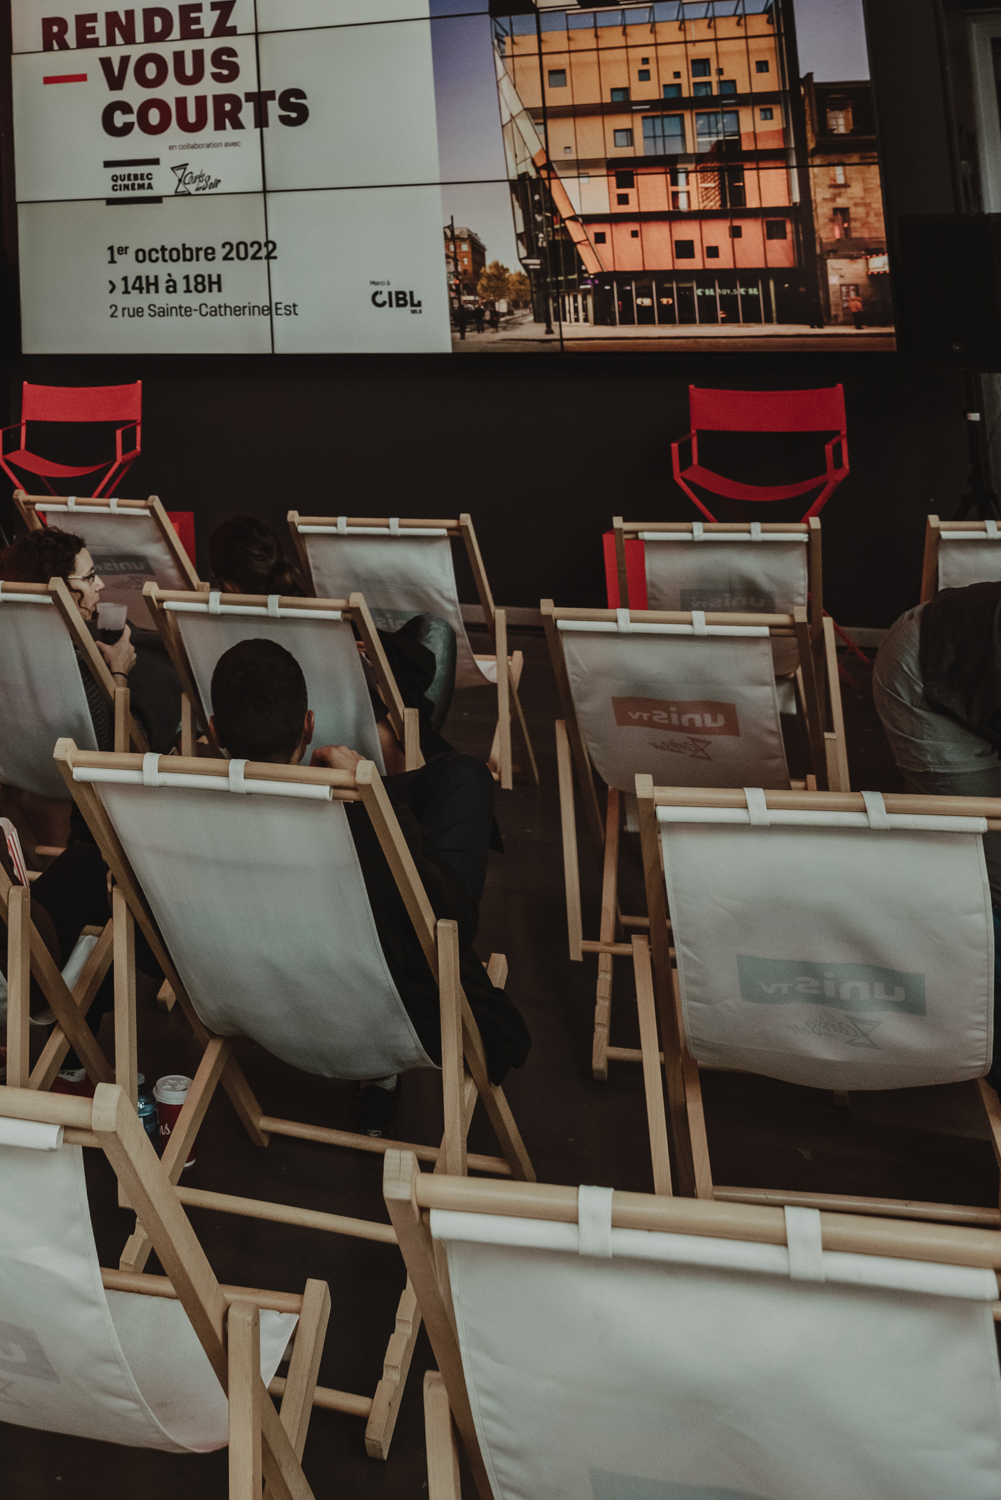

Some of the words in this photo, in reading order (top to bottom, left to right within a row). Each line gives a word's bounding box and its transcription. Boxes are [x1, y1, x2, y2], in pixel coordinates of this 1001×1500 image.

[41, 0, 238, 52] RENDEZ
[99, 46, 240, 91] VOUS
[101, 88, 309, 137] COURTS
[178, 142, 222, 150] collaboration
[111, 172, 153, 183] QUÉBEC
[111, 182, 154, 192] CINÉMA
[107, 245, 130, 264] 1er
[134, 243, 217, 264] octobre
[221, 240, 278, 261] 2022
[121, 275, 160, 295] 14H
[165, 273, 178, 294] à
[182, 273, 222, 294] 18H
[371, 290, 422, 308] CIBL
[109, 304, 118, 318] 2
[121, 305, 145, 318] rue
[148, 302, 270, 318] Sainte-Catherine
[274, 302, 299, 316] Est
